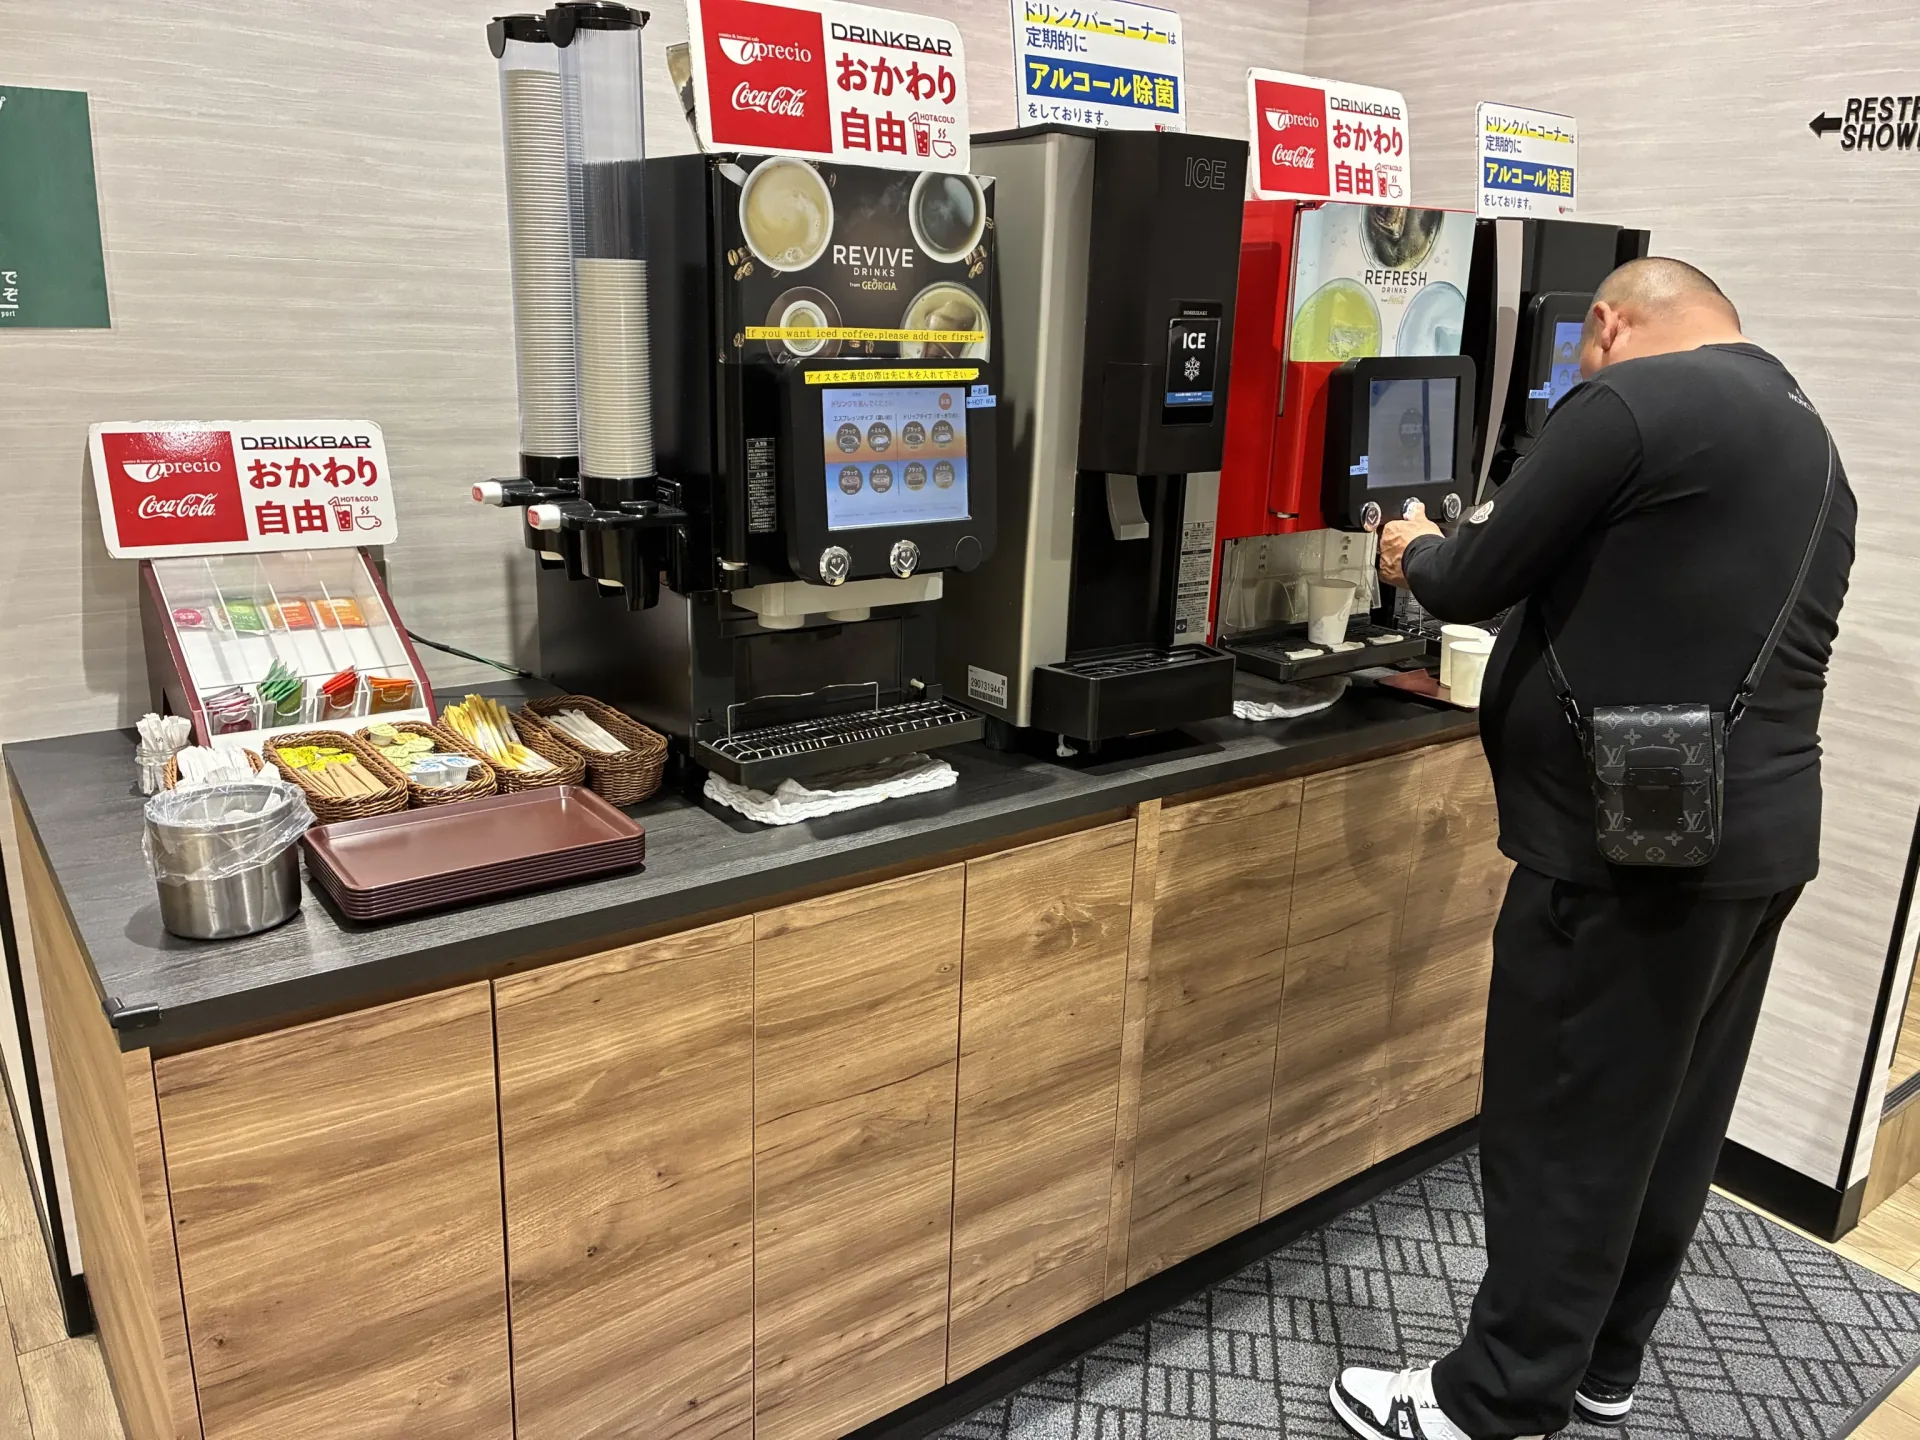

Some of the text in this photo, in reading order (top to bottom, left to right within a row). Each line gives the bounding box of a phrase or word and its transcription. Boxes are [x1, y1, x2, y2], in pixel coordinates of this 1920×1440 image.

[1025, 1, 1177, 45] ドリンクバーコーナーは
[741, 41, 812, 63] aprecio
[831, 22, 953, 56] DRINKBAR
[1026, 26, 1088, 53] 定期的に
[835, 52, 957, 105] おかわり
[1029, 62, 1175, 110] アルコール除菌
[732, 81, 808, 118] Coca-Cola
[1330, 97, 1401, 120] DRINKBAR
[919, 112, 956, 124] HOT&COLD
[1028, 102, 1109, 127] をしております。
[840, 106, 908, 155] 自由
[1332, 119, 1403, 157] おかわり
[1485, 115, 1575, 144] ドリンクバーコーナーは
[1841, 123, 1920, 149] SHOW
[1485, 135, 1522, 154] 定期的に
[1184, 157, 1227, 190] ICE
[1335, 160, 1374, 196] 自由
[1486, 162, 1573, 195] アルコール除菌
[1484, 194, 1532, 210] をしております。
[833, 245, 914, 268] REVIVE
[853, 267, 895, 277] DRINKS
[1365, 270, 1428, 286] REFRESH
[746, 328, 757, 338] If
[761, 329, 781, 339] you
[786, 329, 811, 338] want
[816, 329, 837, 338] iced
[912, 331, 929, 341] add
[934, 332, 948, 341] ice
[1182, 332, 1207, 349] ICE
[241, 436, 372, 450] DRINKBAR
[145, 457, 221, 480] aprecio
[247, 456, 378, 489] おかわり
[138, 493, 219, 519] Coca-Cola
[255, 499, 330, 536] 自由
[971, 677, 1004, 696] 2907319447
